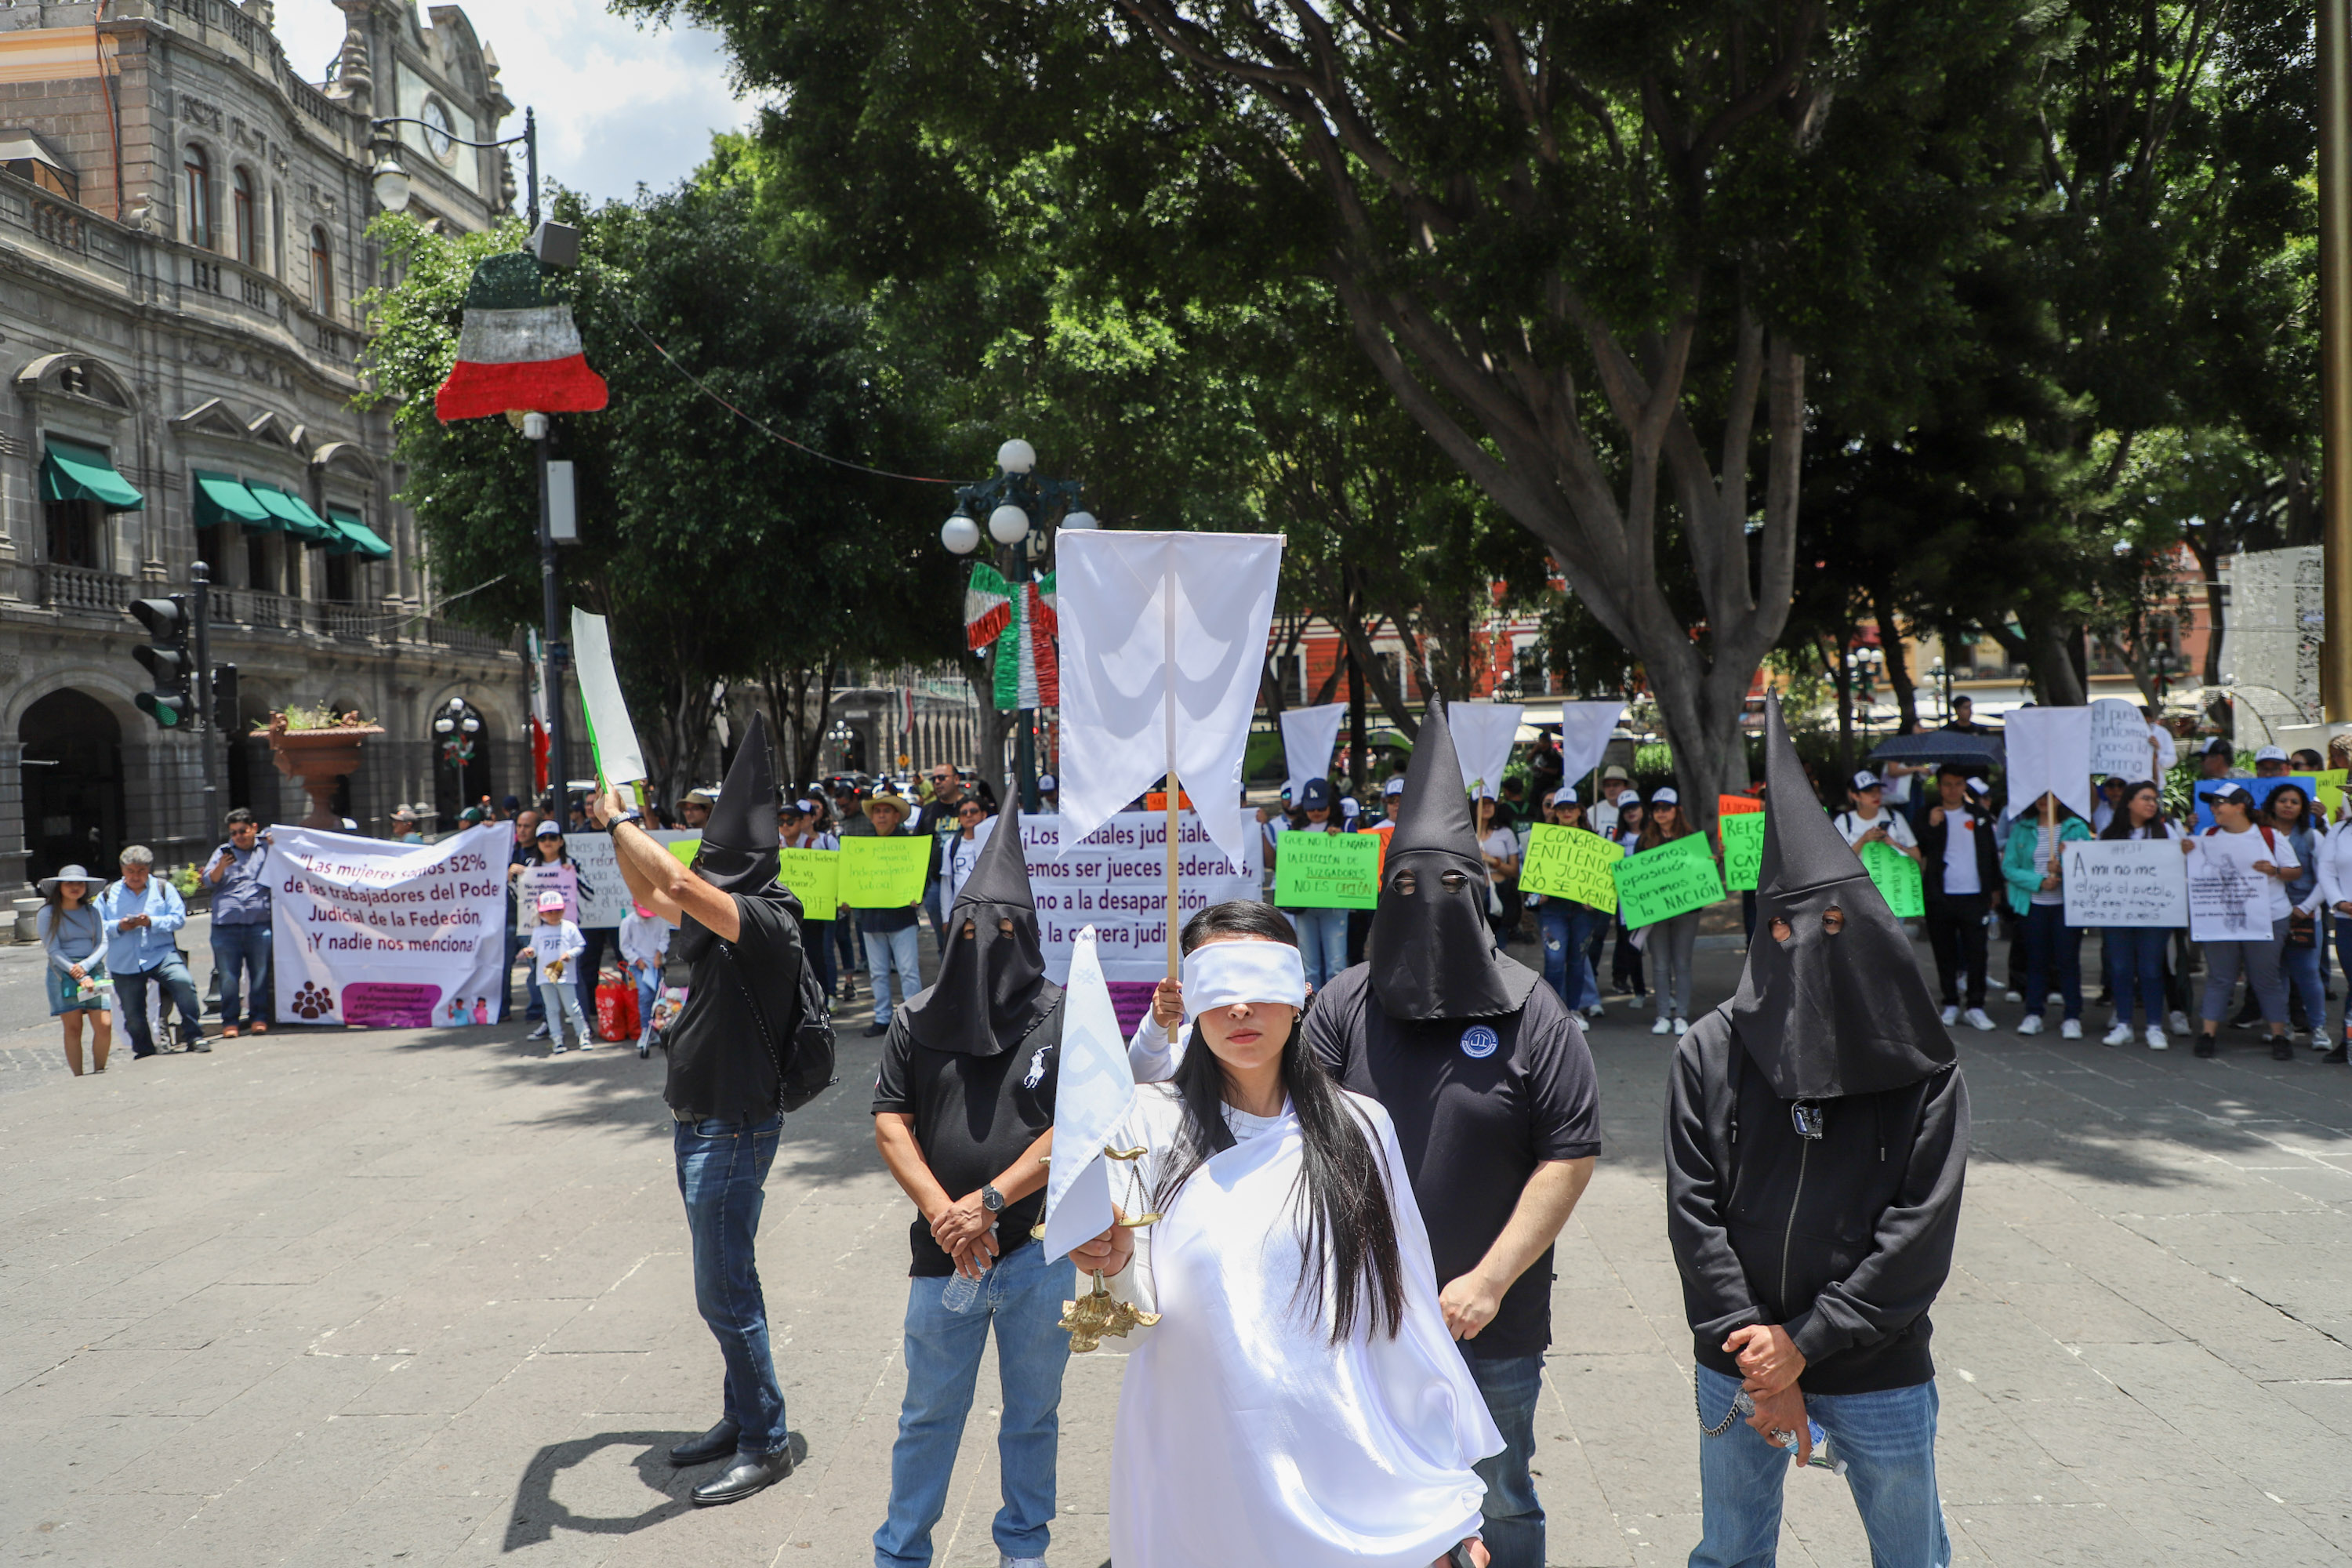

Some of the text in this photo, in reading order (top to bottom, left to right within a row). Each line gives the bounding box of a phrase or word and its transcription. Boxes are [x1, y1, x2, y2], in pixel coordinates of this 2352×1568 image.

[1077, 823, 1134, 844] ciales
[1284, 835, 1305, 845] QUE
[1308, 837, 1322, 847] NO
[1324, 838, 1336, 848] TE
[336, 863, 396, 883] mujeres
[450, 853, 487, 873] 52%
[1076, 863, 1102, 877] ser
[1106, 857, 1162, 883] jueces
[1178, 855, 1252, 877] ederales,
[1613, 847, 1689, 873] No somos
[2073, 851, 2087, 878] A
[2114, 865, 2131, 877] no
[2134, 866, 2158, 877] me
[1294, 879, 1311, 893] NO
[1315, 880, 1330, 892] ES
[1526, 858, 1616, 891] LA JUSTICIA
[1696, 873, 1708, 882] a
[284, 875, 304, 893] de
[307, 878, 327, 896] las
[328, 881, 425, 907] trabajadores
[430, 882, 455, 900] del
[1036, 888, 1207, 915] no a la desaparión
[1521, 876, 1616, 911] NO SE VENDE
[1639, 881, 1720, 918] la NACIÓN
[308, 905, 364, 923] Judicial
[368, 910, 387, 926] de
[390, 910, 405, 927] la
[328, 932, 372, 950] nadie
[378, 939, 404, 950] nos
[1048, 921, 1062, 942] la
[1470, 1033, 1489, 1048] JI
